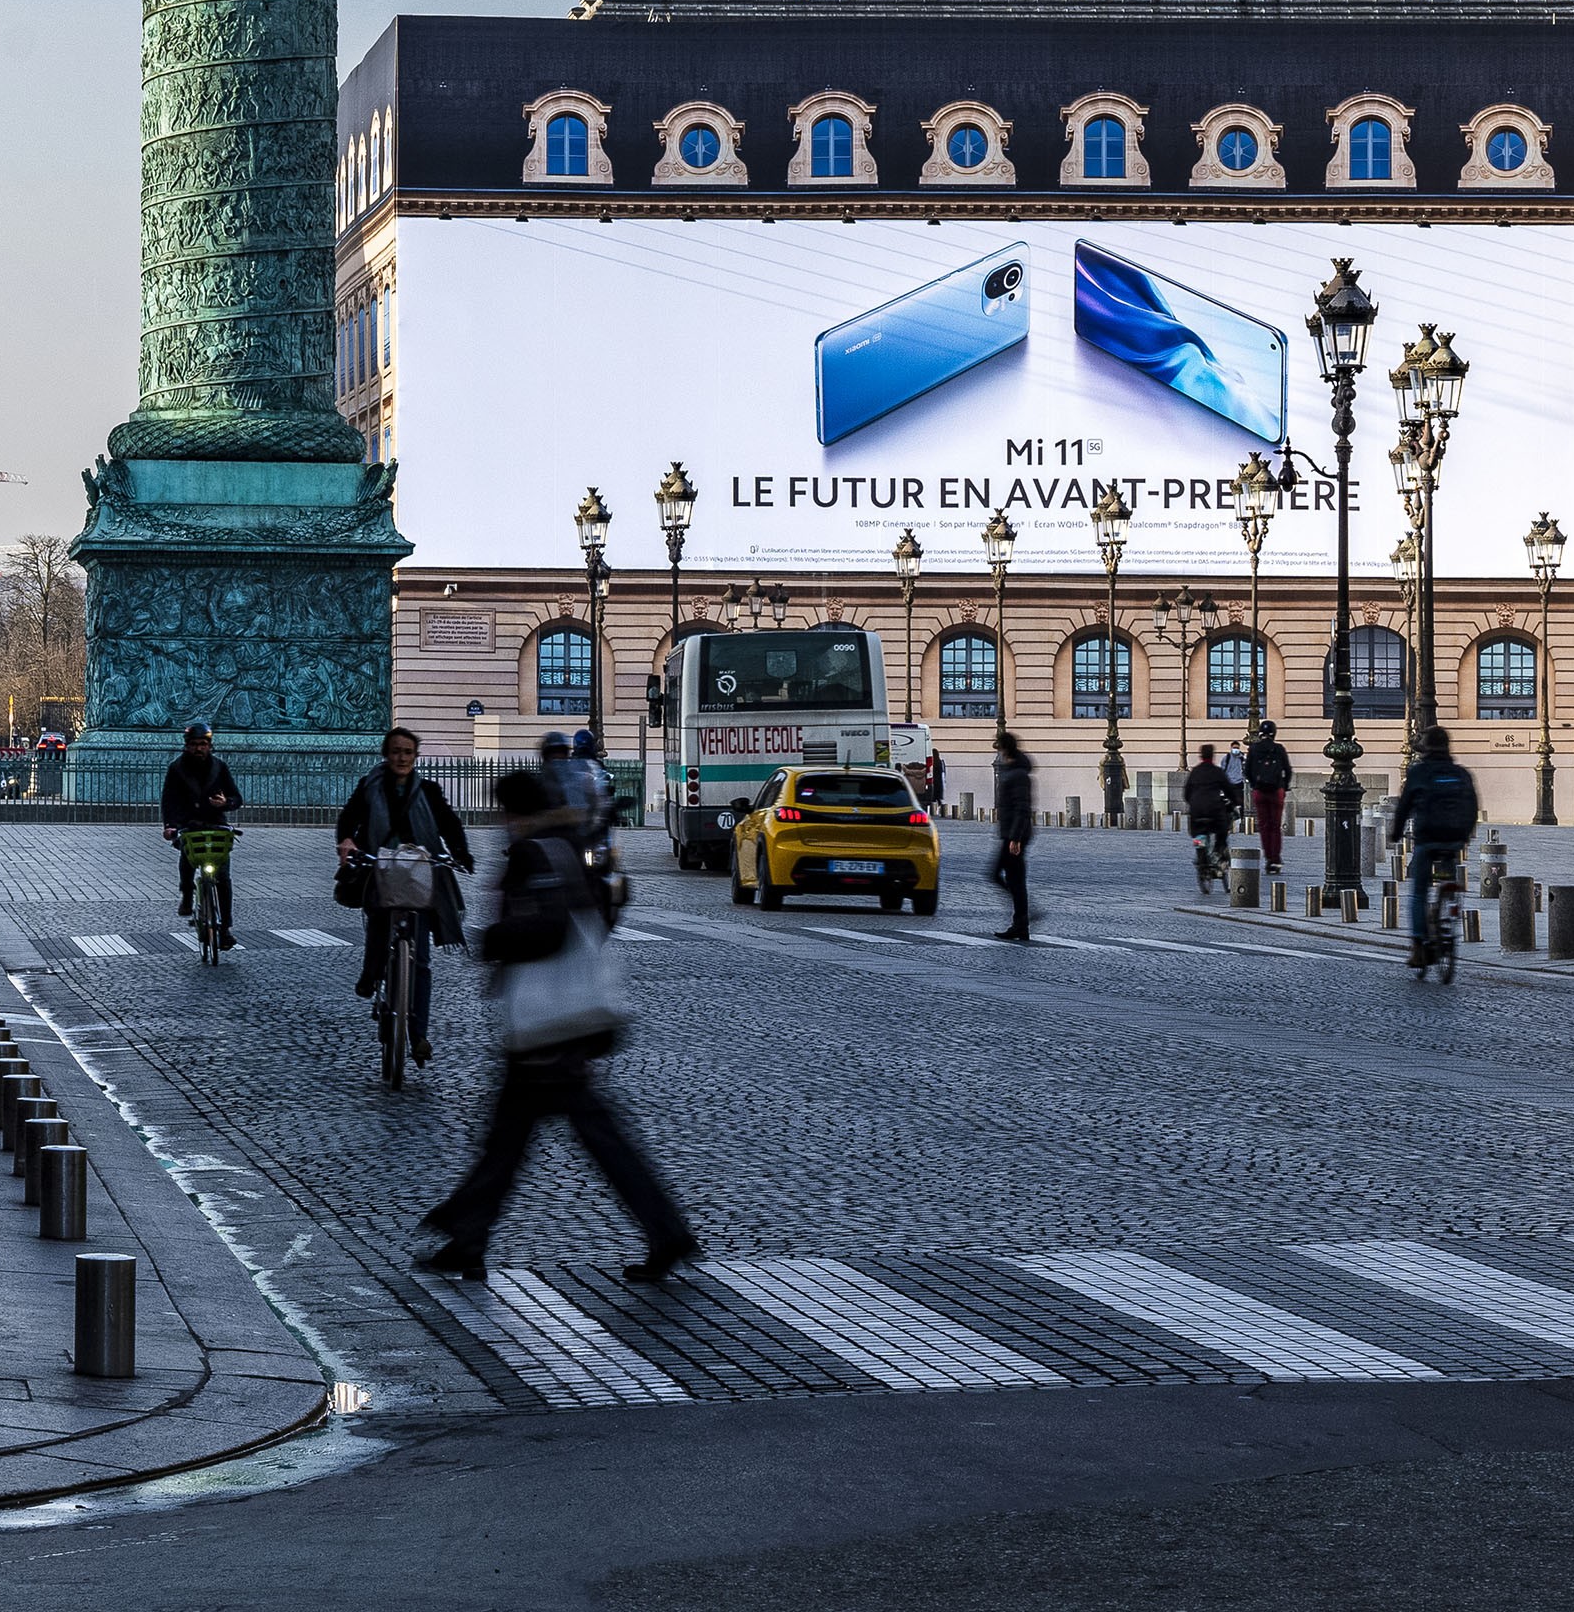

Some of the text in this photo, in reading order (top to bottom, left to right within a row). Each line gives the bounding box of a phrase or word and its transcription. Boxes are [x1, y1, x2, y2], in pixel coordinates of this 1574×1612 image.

[1006, 438, 1101, 466] Mi 11 5G
[732, 476, 1360, 511] LE FUTUR EN AVANT-PREIÈRE
[855, 520, 880, 528] 108MP
[882, 519, 930, 530] Cinématique
[939, 520, 953, 528] Son
[954, 521, 965, 530] par
[1034, 519, 1055, 529] Écran
[1058, 521, 1088, 529] WQHD+
[833, 643, 856, 652] 0090
[840, 729, 870, 737] IVECO
[721, 814, 732, 828] 70
